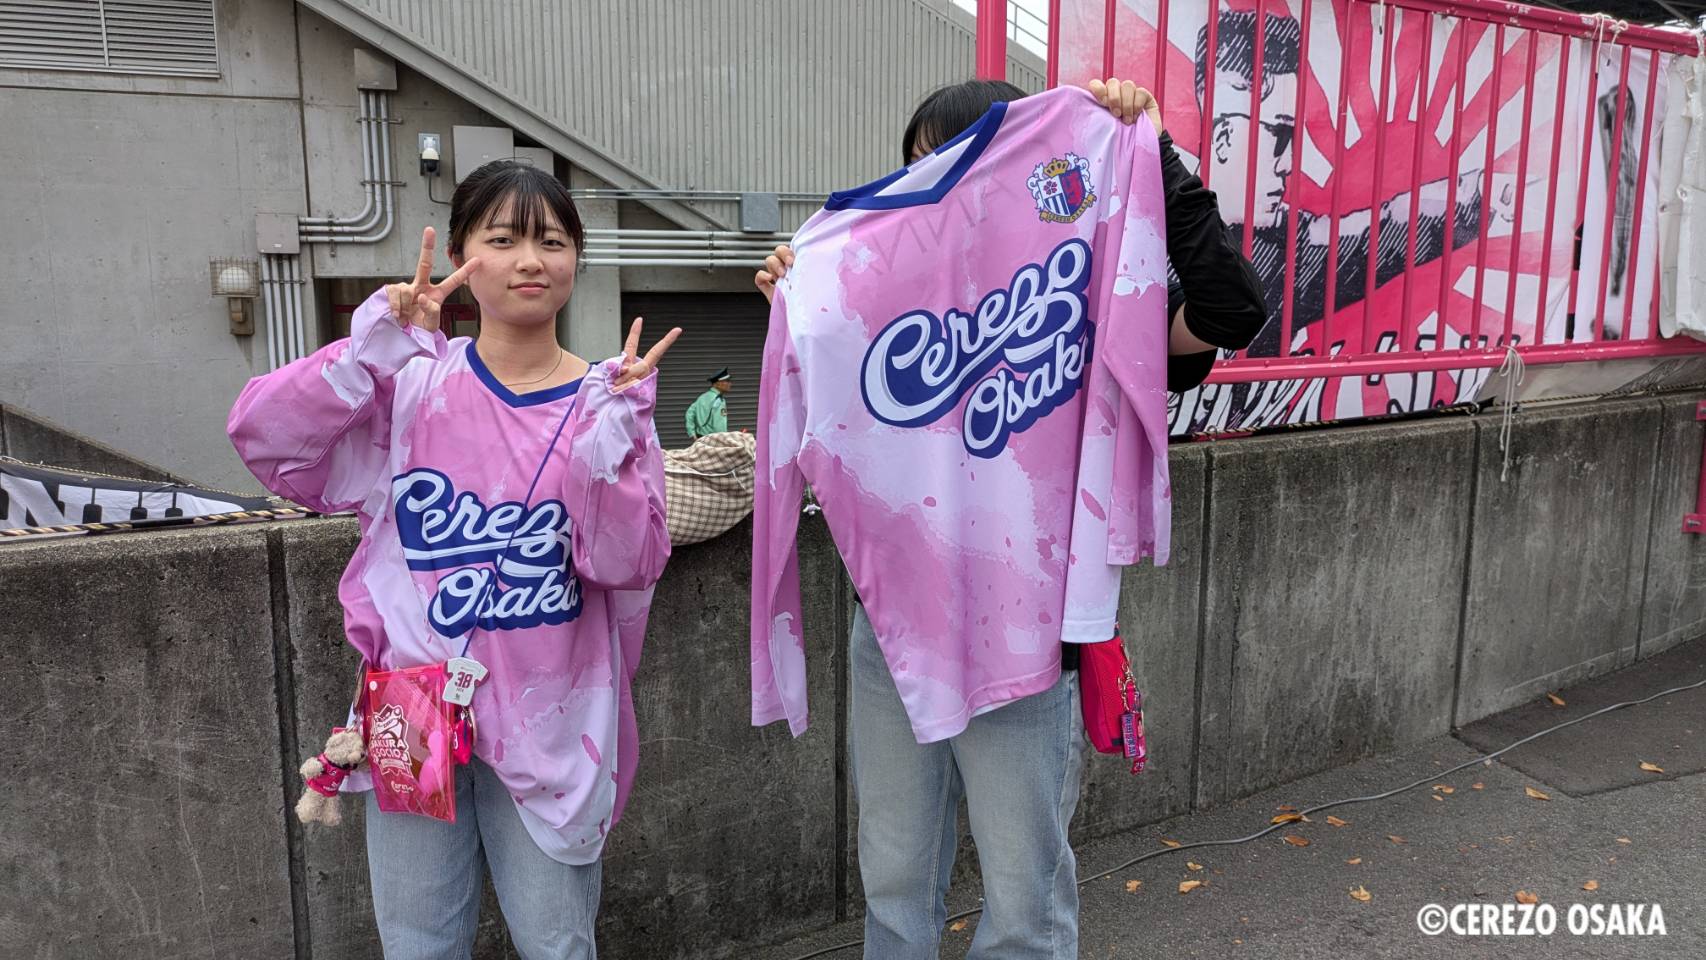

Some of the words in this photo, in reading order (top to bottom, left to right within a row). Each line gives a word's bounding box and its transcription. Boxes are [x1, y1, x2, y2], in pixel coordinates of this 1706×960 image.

[862, 239, 1090, 428] Cerezo
[962, 327, 1091, 459] Osak
[454, 671, 474, 689] 38
